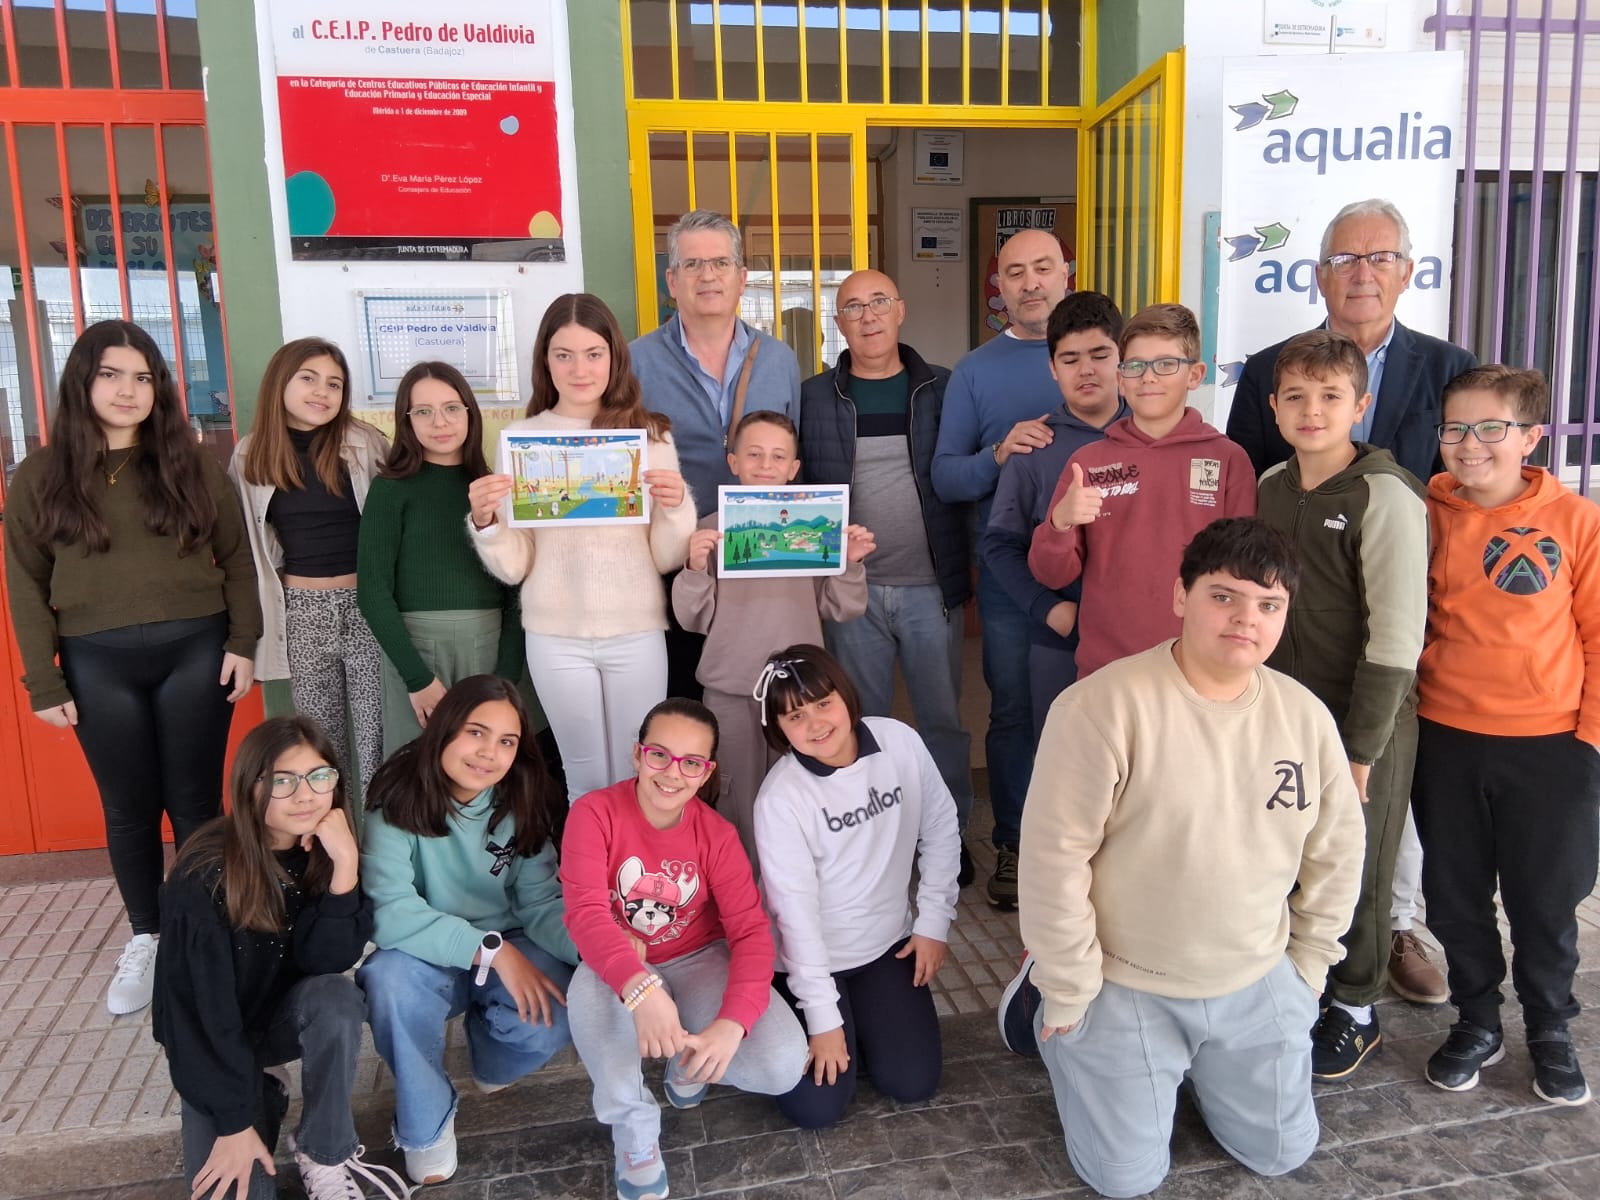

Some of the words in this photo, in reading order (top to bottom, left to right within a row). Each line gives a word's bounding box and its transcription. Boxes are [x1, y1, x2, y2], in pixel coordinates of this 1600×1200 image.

[292, 25, 304, 39] al
[312, 20, 376, 40] C.E.I.P.
[382, 21, 433, 42] Pedro
[438, 24, 458, 43] de
[464, 24, 535, 45] Valdivia
[365, 46, 376, 55] de
[378, 45, 421, 56] Castuera
[423, 46, 465, 57] (Badajoz)
[290, 80, 300, 88] en
[301, 79, 309, 88] la
[347, 80, 357, 89] de
[358, 80, 387, 90] Centros
[387, 80, 427, 90] Educativos
[429, 80, 460, 90] Públicos
[461, 82, 470, 91] de
[471, 82, 508, 92] Educación
[509, 83, 536, 92] Infantil
[345, 89, 382, 99] Educación
[384, 90, 416, 100] Primaria
[424, 91, 461, 101] Educación
[462, 92, 492, 101] Especial
[414, 107, 443, 116] diciembre
[444, 108, 452, 116] de
[1263, 112, 1453, 175] aqualia
[392, 175, 408, 183] Eva
[434, 175, 457, 184] Pérez
[458, 176, 483, 185] López
[86, 209, 213, 233] DIERETES
[998, 210, 1032, 228] LIBROS
[1035, 210, 1054, 228] QUE
[131, 236, 158, 257] SU
[398, 245, 417, 254] JUNTA
[417, 245, 425, 254] DE
[426, 245, 469, 254] EXTREMADURA
[441, 324, 453, 332] de
[415, 338, 465, 347] (Castuera)
[1266, 760, 1312, 811] A
